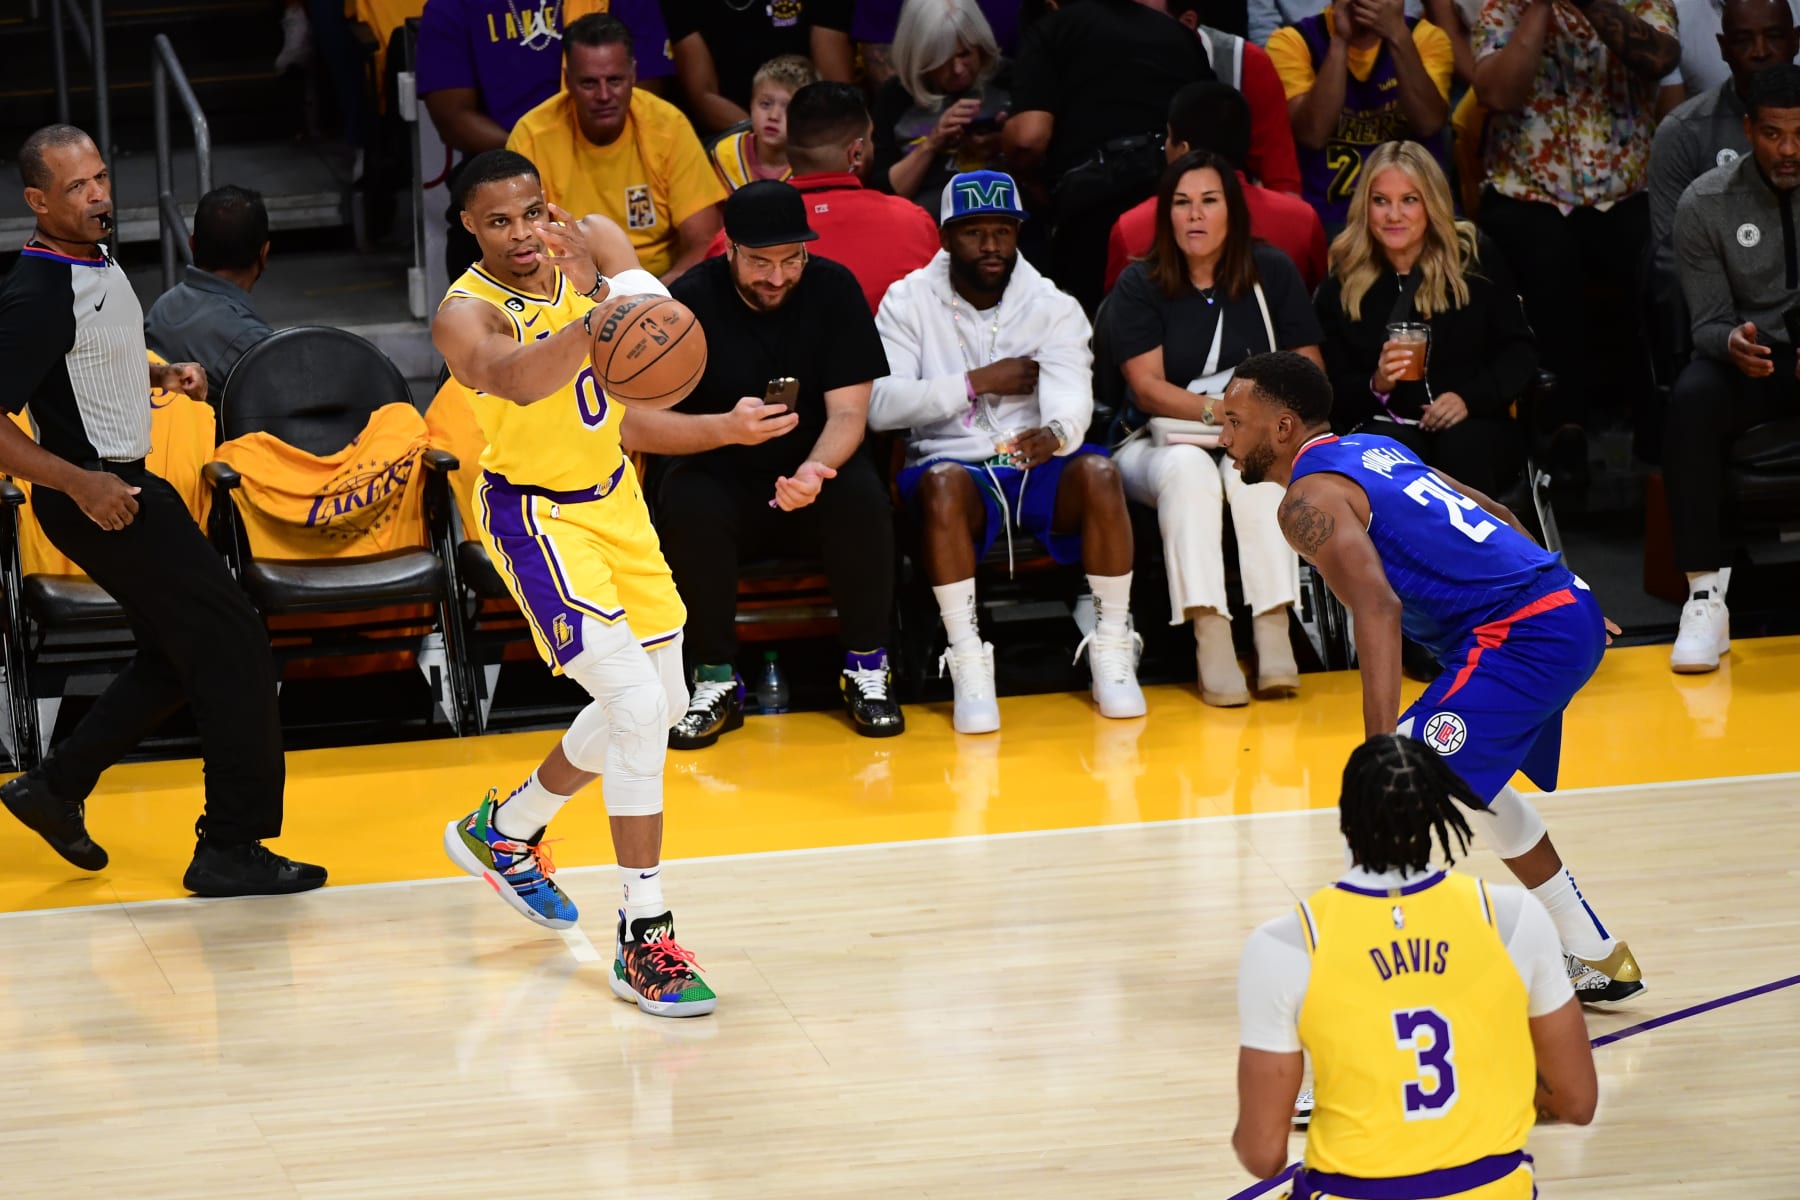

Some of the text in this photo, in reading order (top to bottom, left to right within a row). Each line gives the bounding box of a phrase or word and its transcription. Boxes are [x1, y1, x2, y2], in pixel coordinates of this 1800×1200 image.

[506, 298, 524, 312] 6
[574, 365, 609, 431] 0
[1369, 938, 1449, 981] DAVIS
[1392, 1006, 1459, 1120] 3
